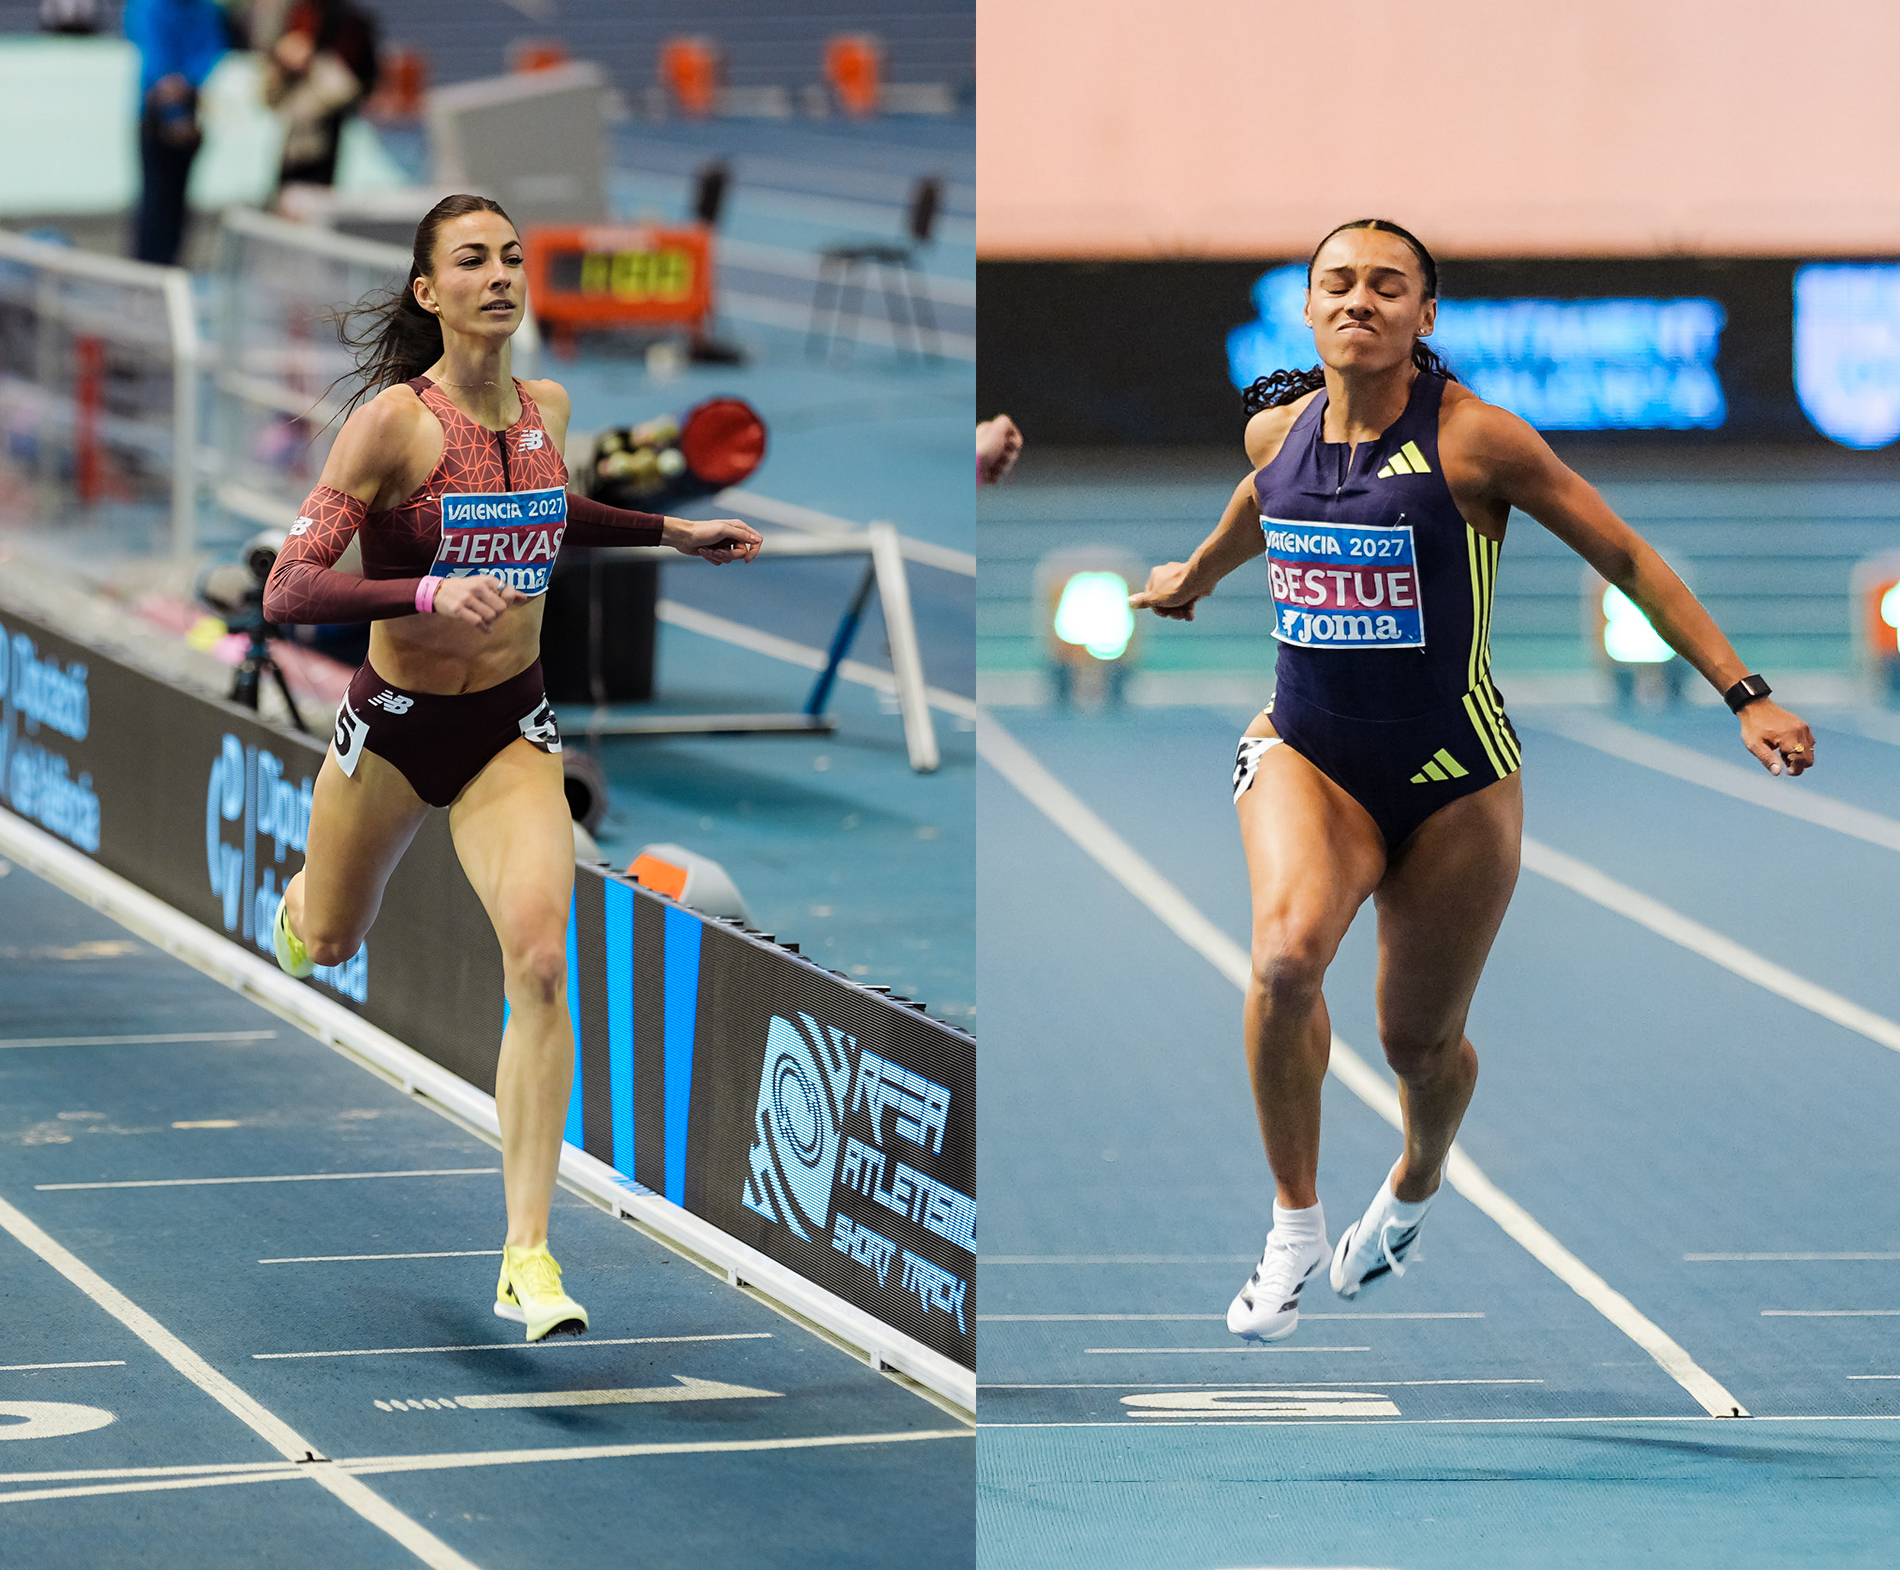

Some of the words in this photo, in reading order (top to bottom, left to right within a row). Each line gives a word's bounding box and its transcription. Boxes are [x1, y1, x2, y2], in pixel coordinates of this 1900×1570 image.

[448, 503, 523, 520] VALENCIA
[528, 497, 563, 517] 2027
[438, 527, 564, 563] HERVAS
[1264, 529, 1342, 555] VALENCIA
[1350, 538, 1404, 557] 2027
[1270, 562, 1414, 608] BESTUE
[831, 1212, 897, 1288] SHORT
[901, 1248, 967, 1335] TRACK
